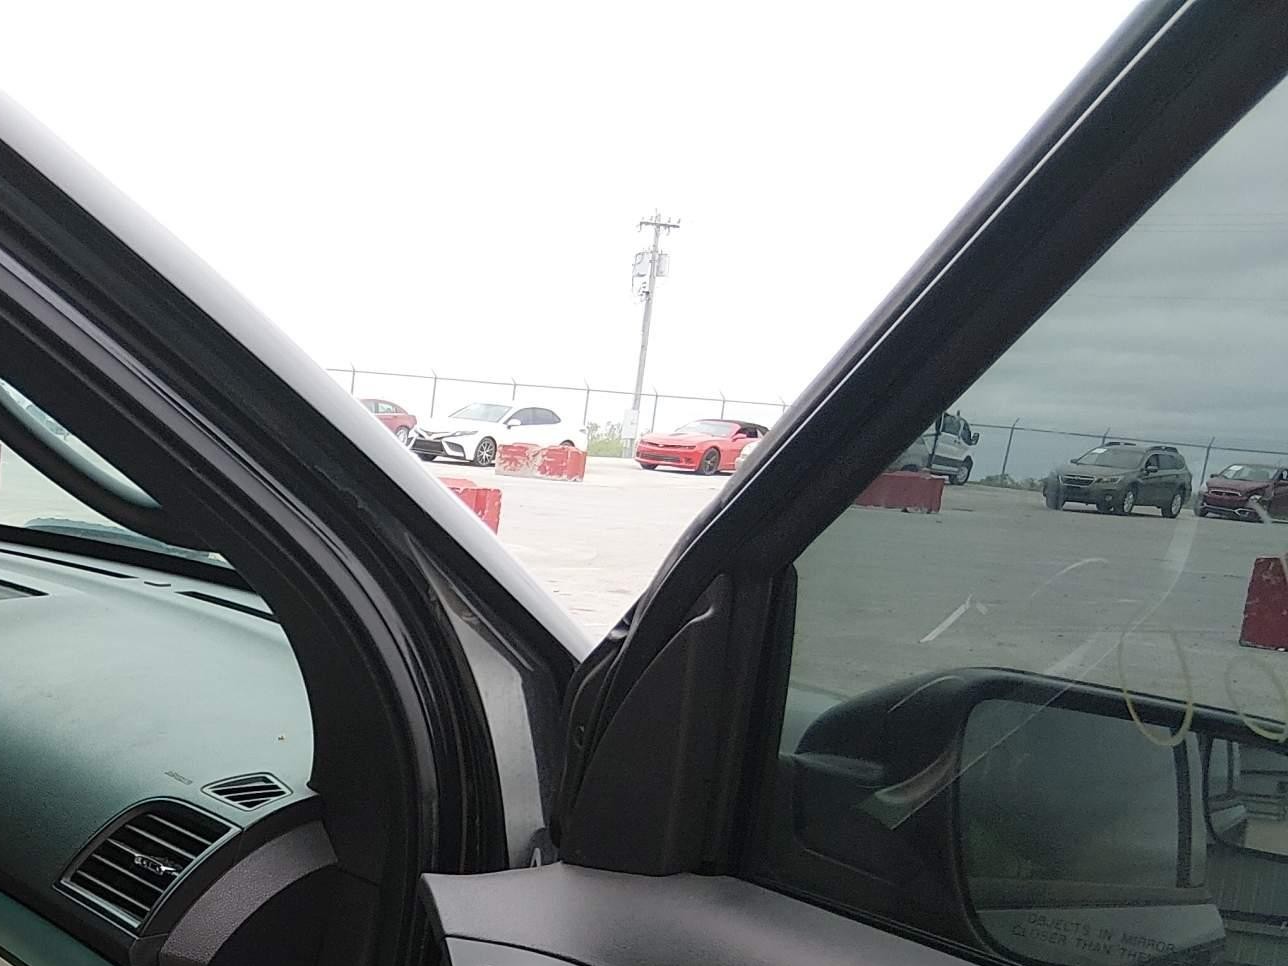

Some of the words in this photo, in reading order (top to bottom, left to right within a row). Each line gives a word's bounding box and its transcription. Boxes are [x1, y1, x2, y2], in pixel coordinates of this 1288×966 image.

[1027, 912, 1091, 937] OBJECTS
[1098, 928, 1113, 942] IN
[1120, 932, 1176, 954] MIRROR
[1076, 938, 1112, 955] THAN
